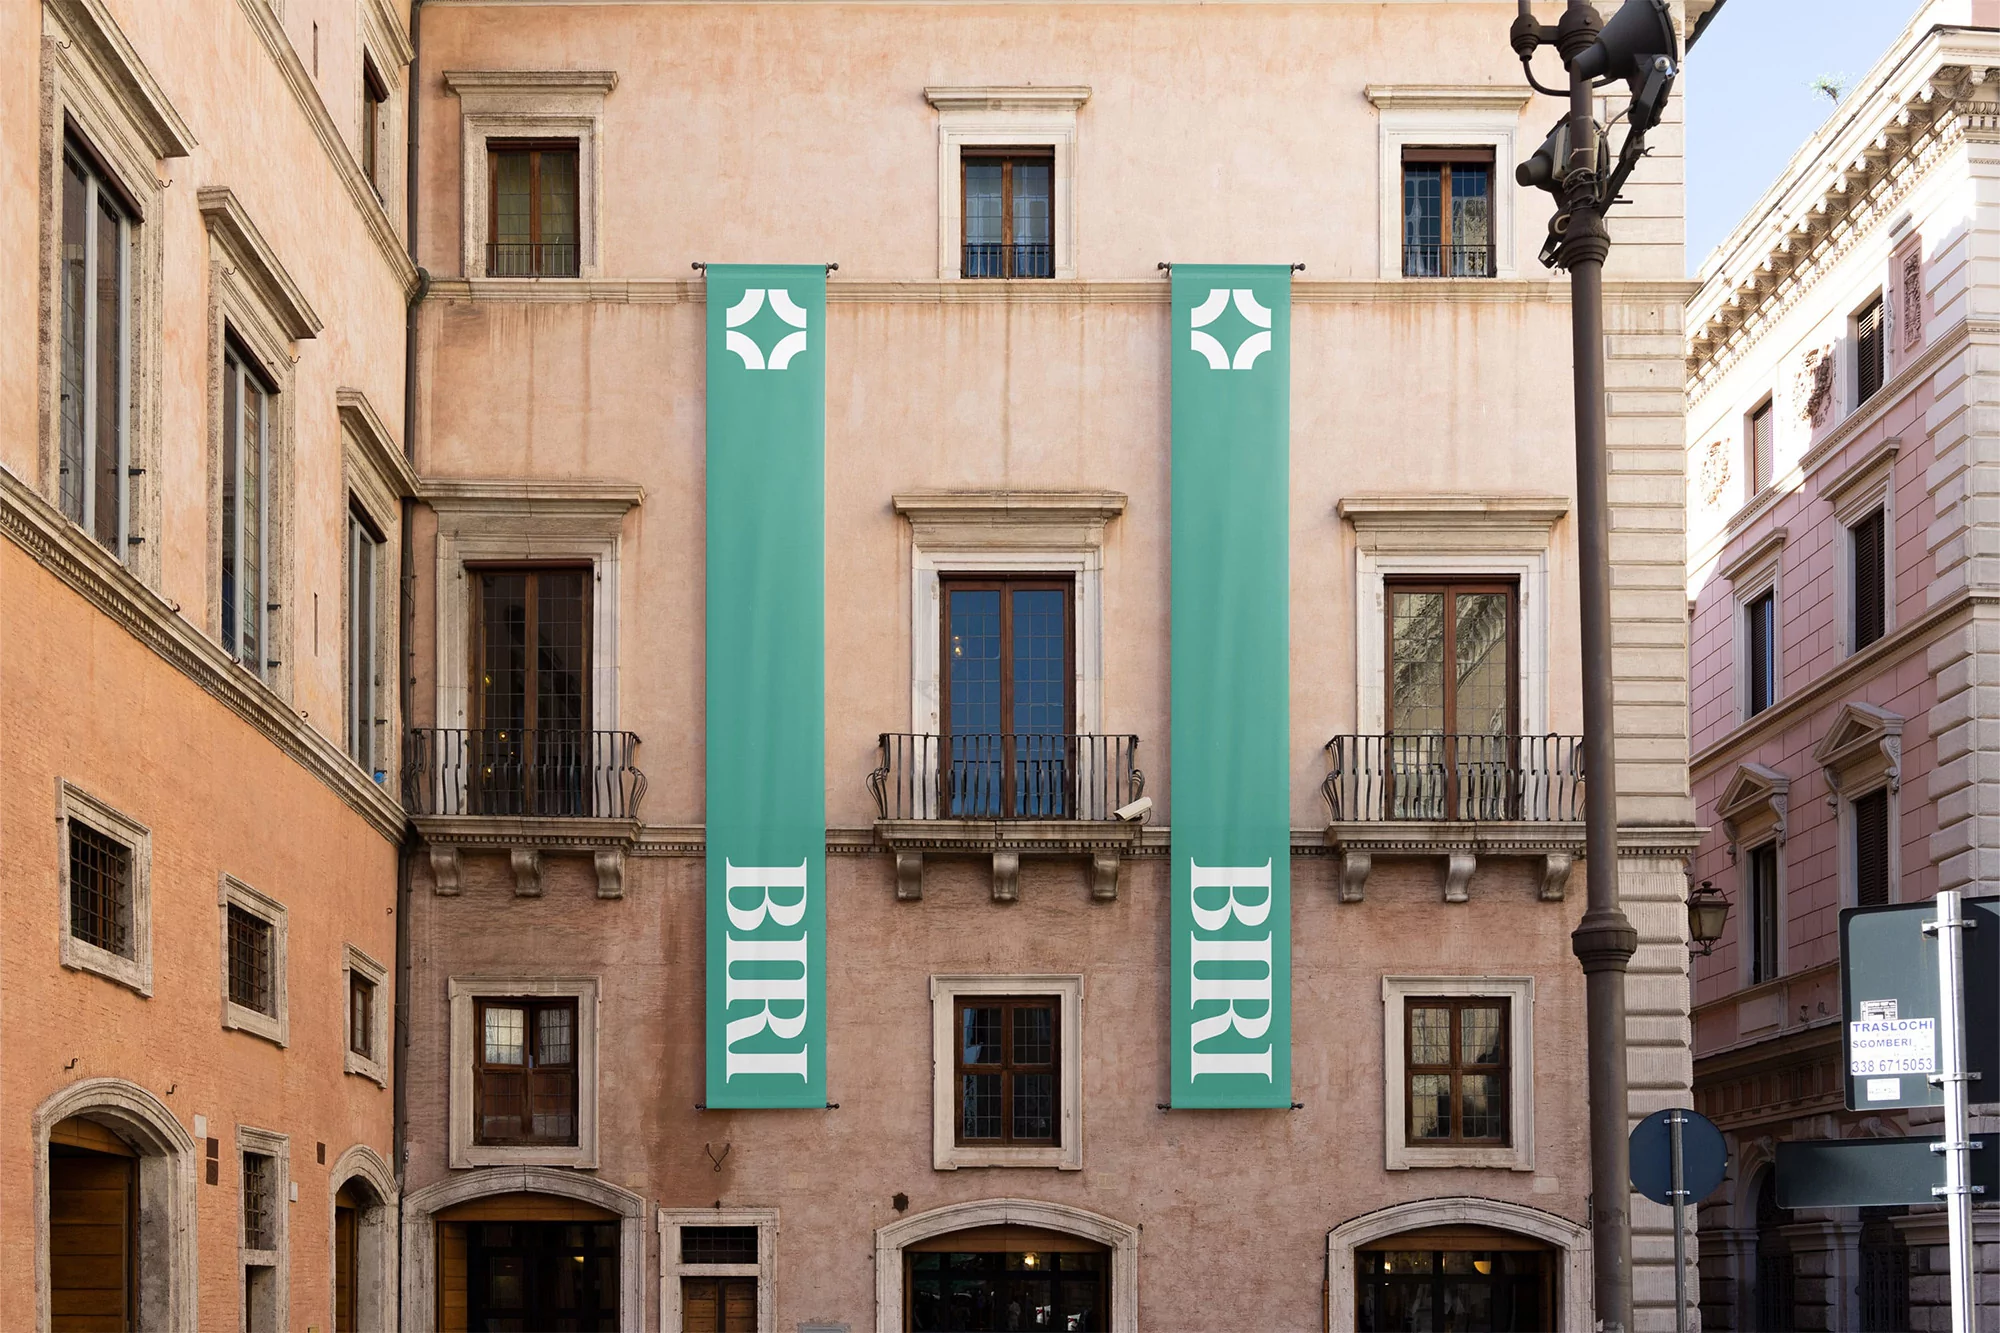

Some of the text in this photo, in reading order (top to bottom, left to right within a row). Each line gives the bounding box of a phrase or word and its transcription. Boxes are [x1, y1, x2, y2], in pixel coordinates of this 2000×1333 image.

[726, 857, 808, 1083] BIRI
[1190, 857, 1272, 1083] BIRI
[1853, 1020, 1933, 1032] TRASLOCHI
[1852, 1039, 1912, 1048] SGOMBERI
[1852, 1058, 1932, 1073] 338 6715053
